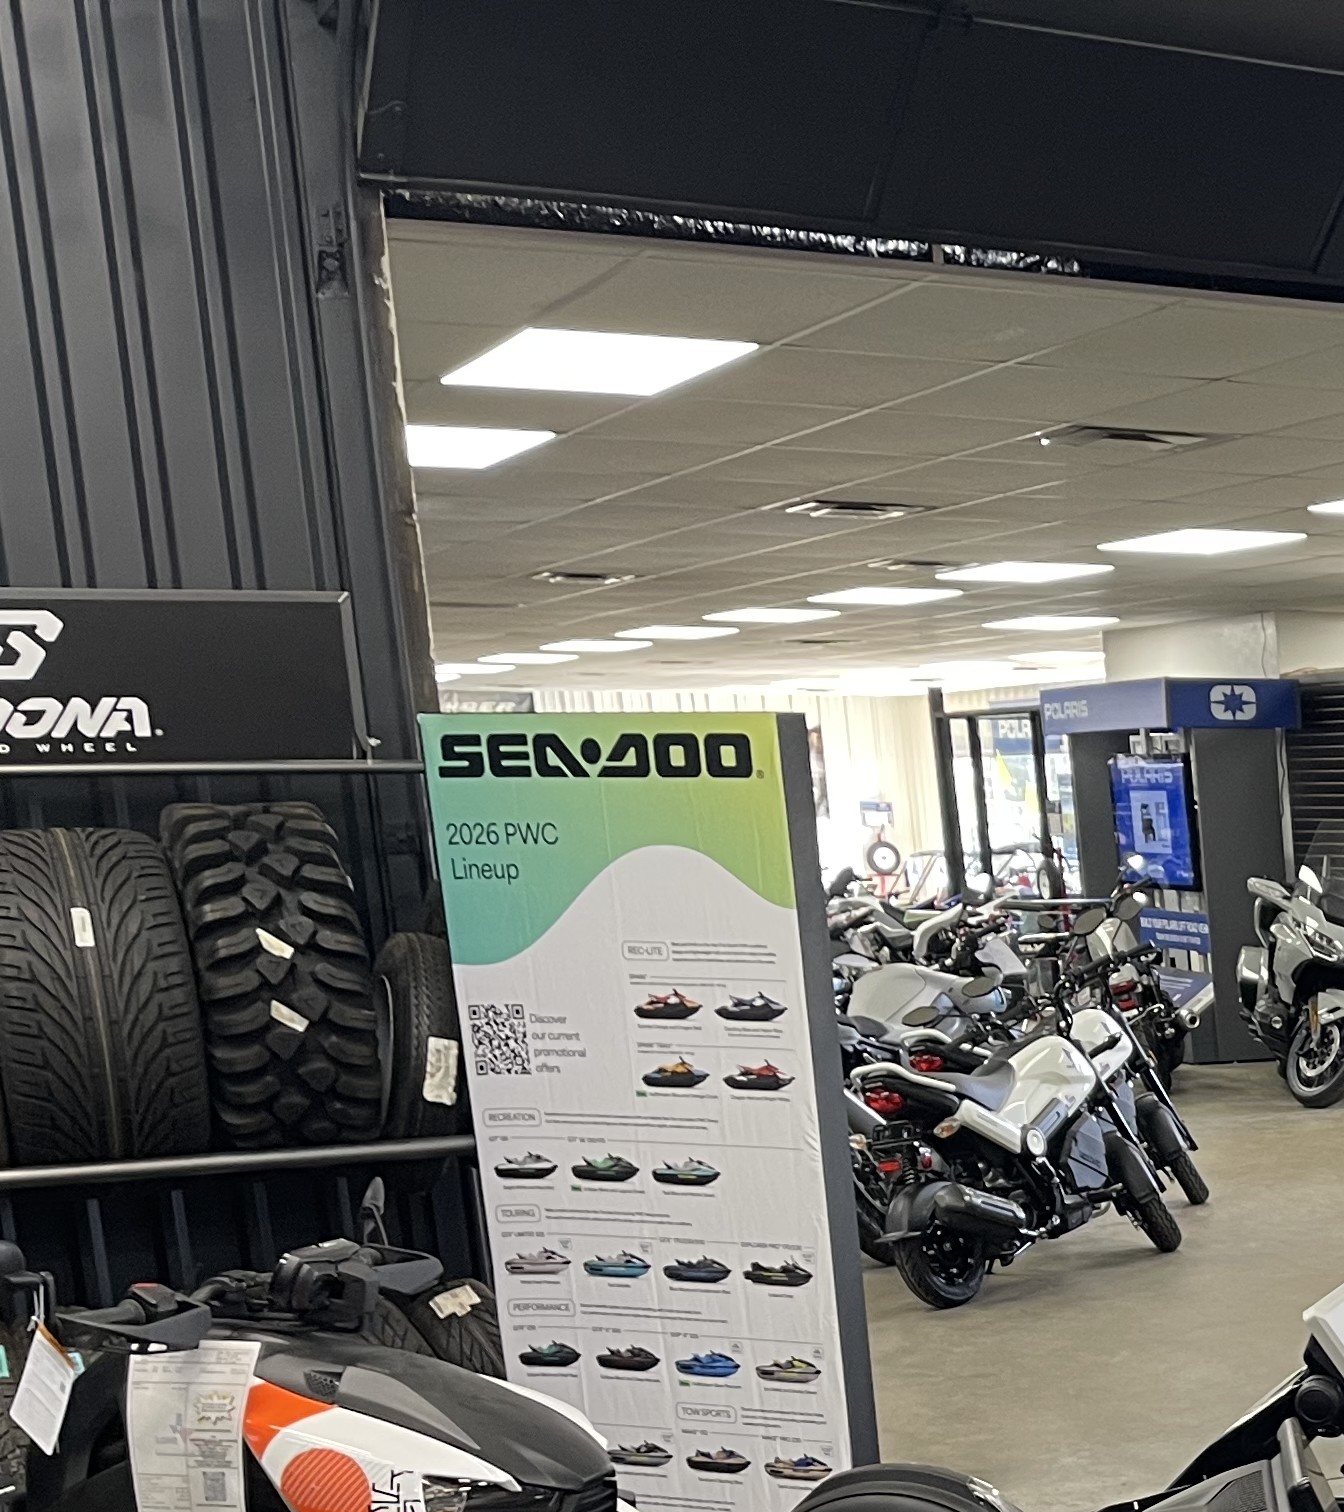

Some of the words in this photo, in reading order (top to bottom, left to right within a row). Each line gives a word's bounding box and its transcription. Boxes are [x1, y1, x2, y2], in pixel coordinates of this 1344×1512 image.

[1043, 701, 1089, 720] POLARIS
[998, 717, 1032, 739] POLA
[36, 743, 137, 753] WHEEL
[1121, 767, 1173, 784] POLARIS
[446, 822, 500, 846] 2026
[504, 822, 559, 846] PWC
[451, 857, 520, 885] Lineup
[529, 1012, 567, 1024] Discover
[547, 1032, 580, 1041] current
[534, 1047, 587, 1058] promotional
[488, 1112, 536, 1122] RECREATION
[500, 1208, 536, 1218] TOURING
[512, 1303, 571, 1312] PERFORMANCE
